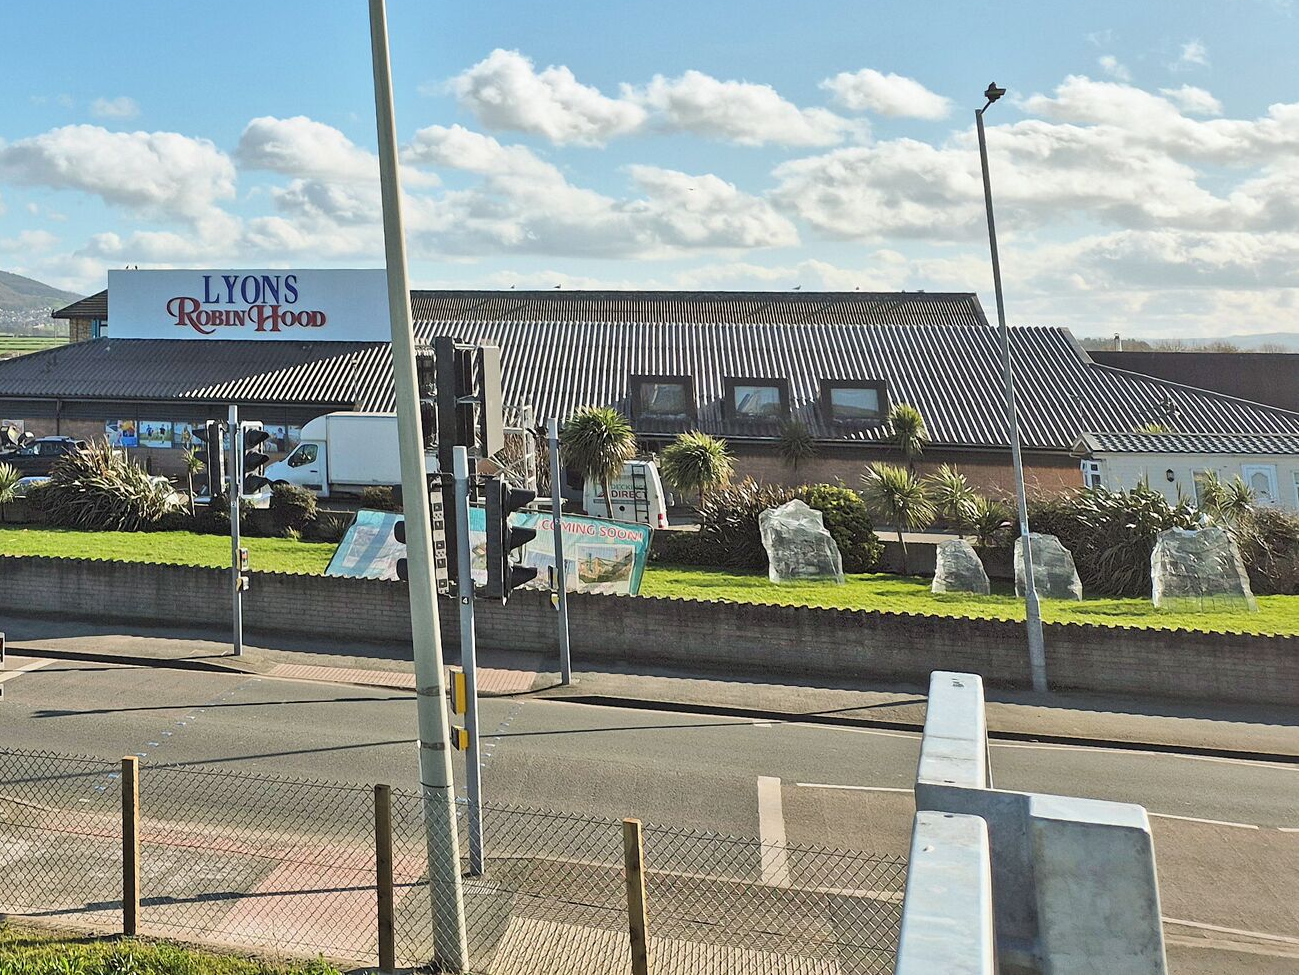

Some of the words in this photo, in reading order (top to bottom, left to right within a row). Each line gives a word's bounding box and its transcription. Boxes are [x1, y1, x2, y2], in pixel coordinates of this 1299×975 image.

[202, 275, 299, 304] LYONS
[167, 296, 247, 334] ROBIN
[248, 304, 326, 332] HOOD
[611, 490, 647, 499] DIRECT
[600, 526, 643, 541] SOON!
